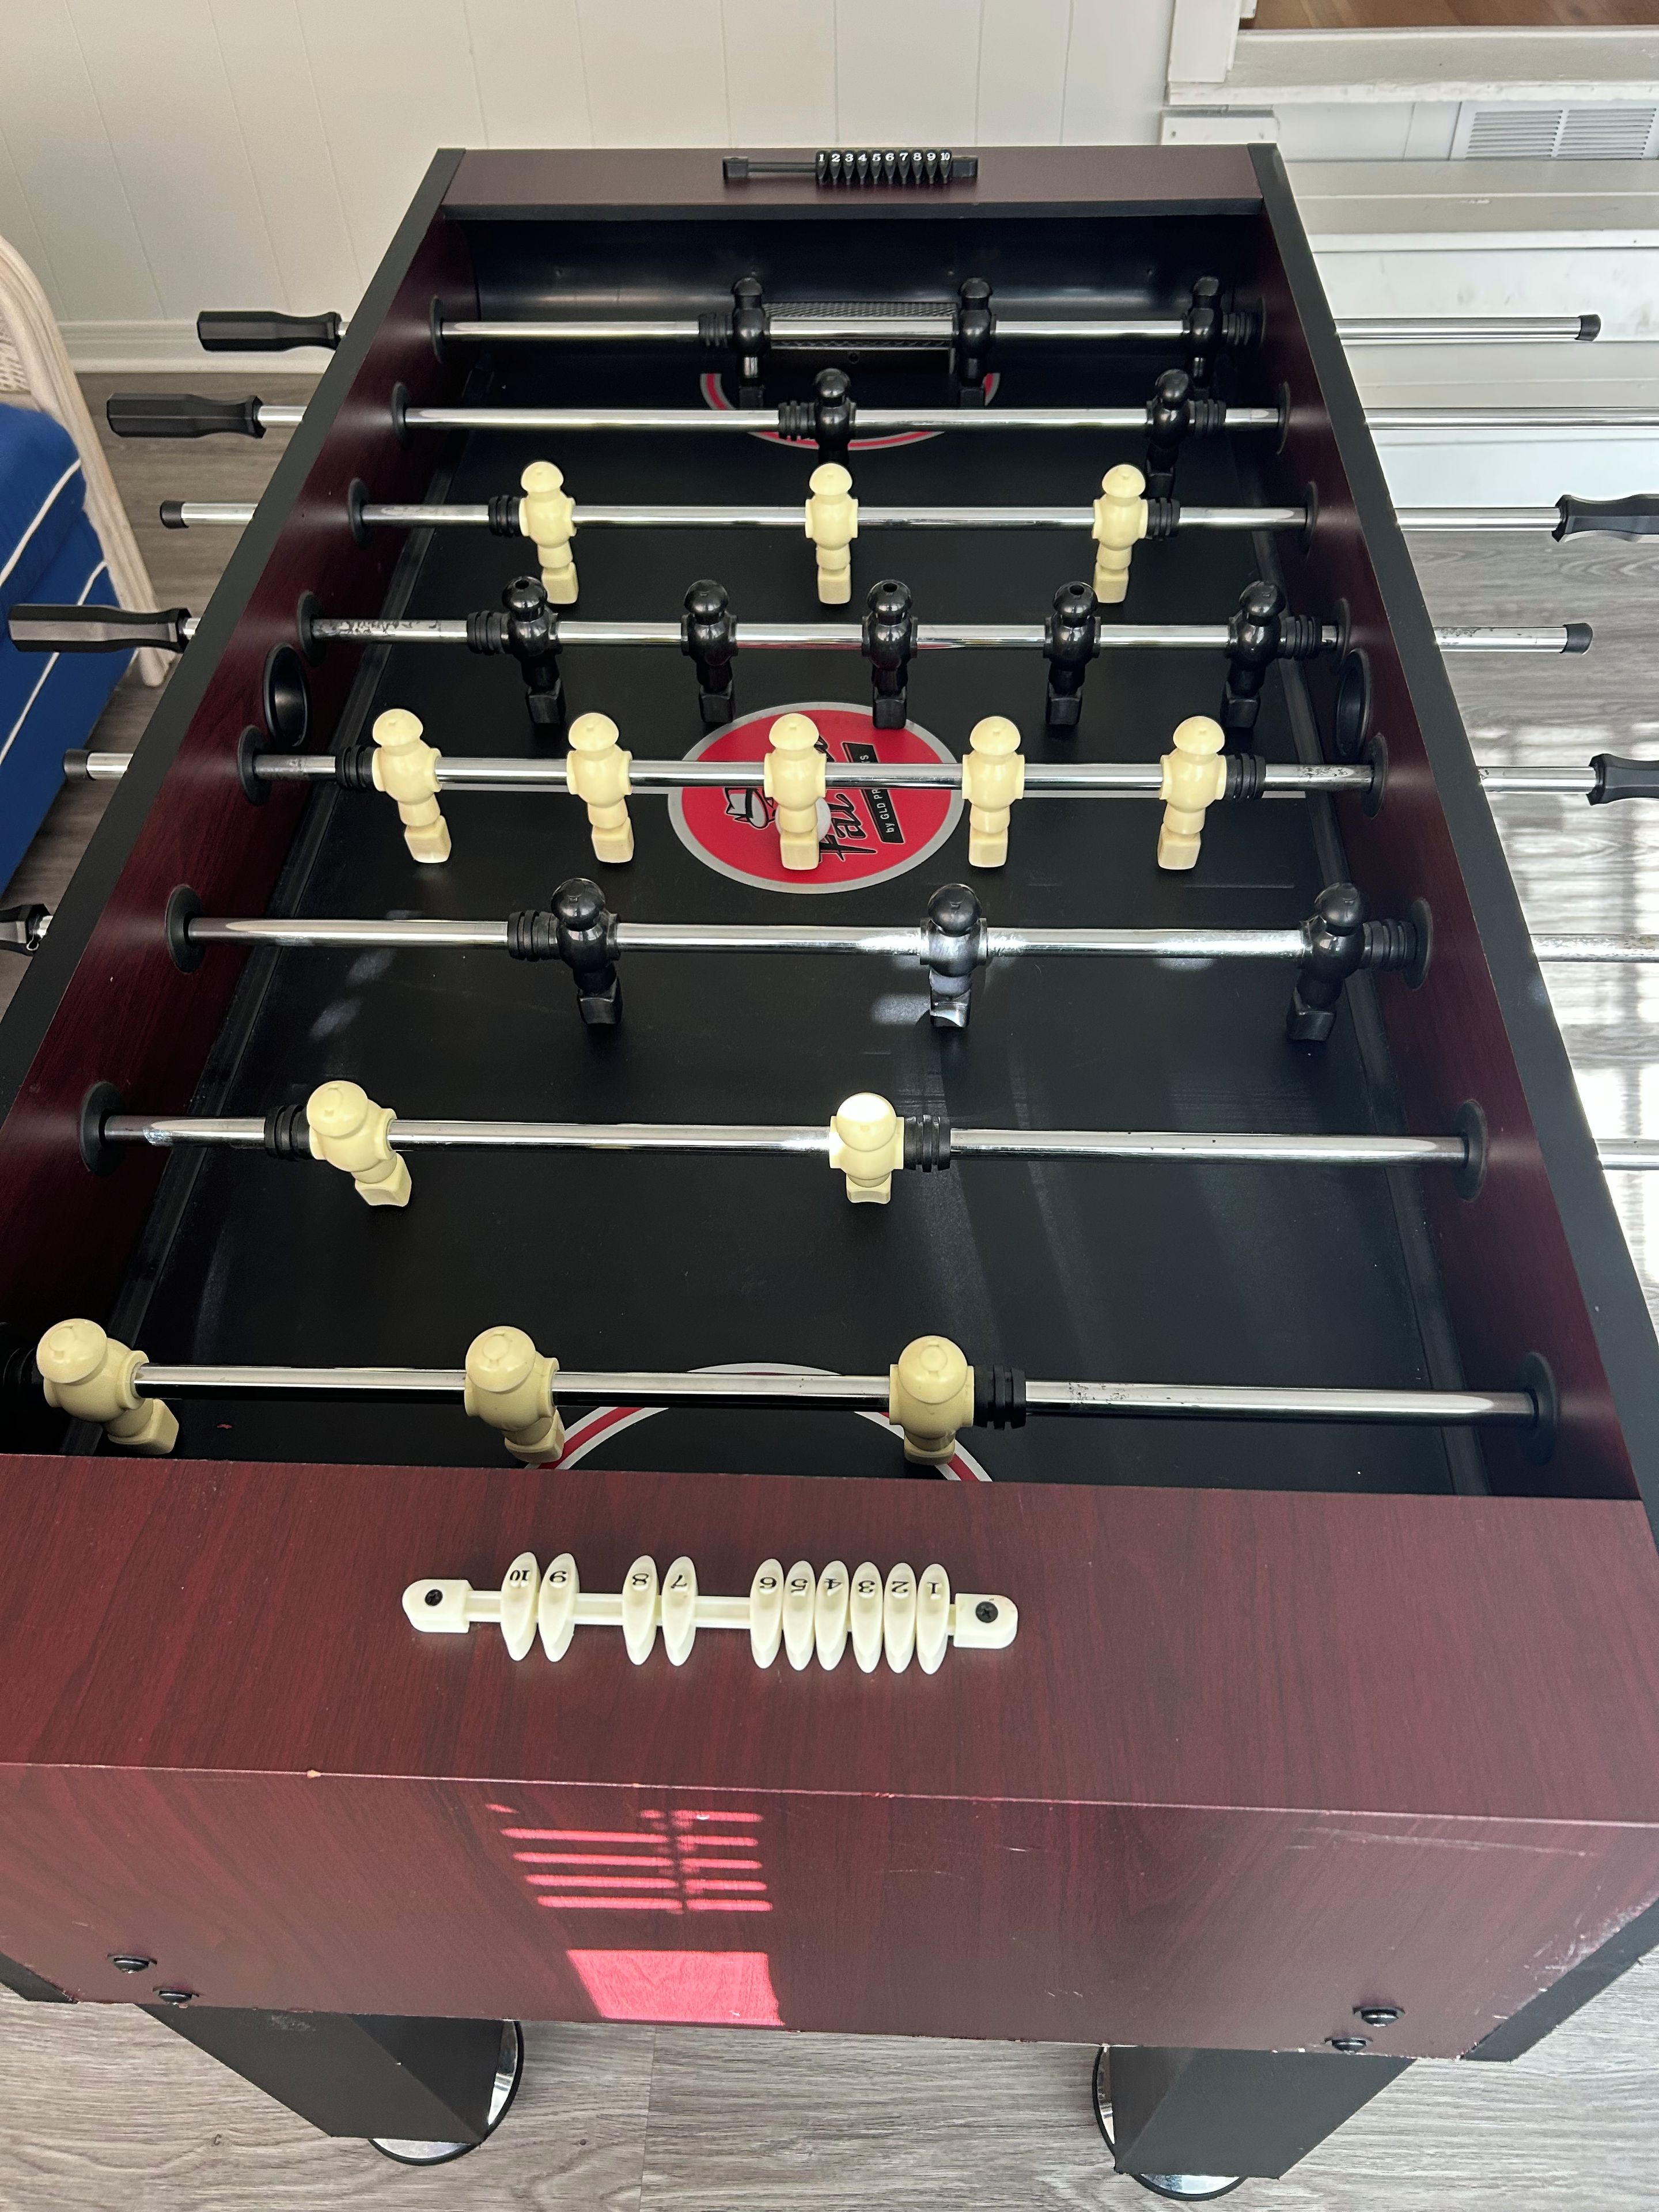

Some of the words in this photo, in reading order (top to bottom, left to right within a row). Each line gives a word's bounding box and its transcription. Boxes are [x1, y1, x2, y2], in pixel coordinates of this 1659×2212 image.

[819, 154, 824, 162] 1
[831, 154, 840, 162] 2
[844, 153, 854, 162] 3
[858, 153, 867, 161] 4
[872, 153, 881, 161] 5
[885, 153, 895, 161] 6
[899, 152, 908, 161] 7
[912, 153, 922, 161] 8
[926, 152, 936, 161] 9
[940, 152, 950, 161] 10
[876, 802, 890, 820] GLD
[885, 823, 895, 833] by
[509, 1570, 530, 1581] 10
[549, 1570, 567, 1583] 9
[632, 1573, 649, 1585] 8
[671, 1574, 688, 1589] 7
[759, 1577, 777, 1589] 6
[790, 1578, 808, 1593] 5
[824, 1578, 843, 1590] 4
[858, 1580, 876, 1593] 3
[891, 1581, 909, 1593] 2
[927, 1581, 940, 1594] 1
